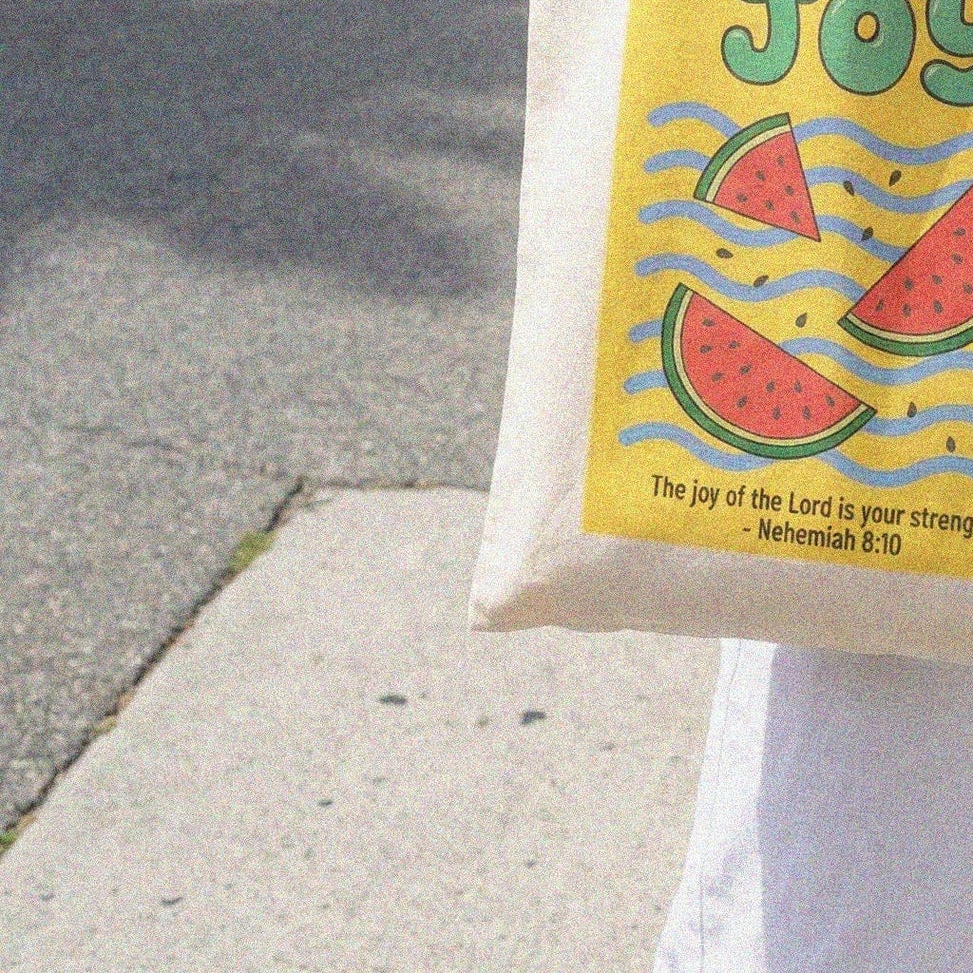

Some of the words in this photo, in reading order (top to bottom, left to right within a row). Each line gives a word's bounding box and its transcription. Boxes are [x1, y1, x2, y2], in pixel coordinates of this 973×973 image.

[652, 475, 686, 500] The
[691, 480, 720, 509] joy
[726, 485, 746, 507] of
[751, 488, 781, 512] the
[789, 492, 832, 518] Lord
[838, 496, 854, 521] is
[860, 504, 905, 527] your
[758, 518, 856, 551] Nehemiah
[862, 531, 901, 556] 8:10
